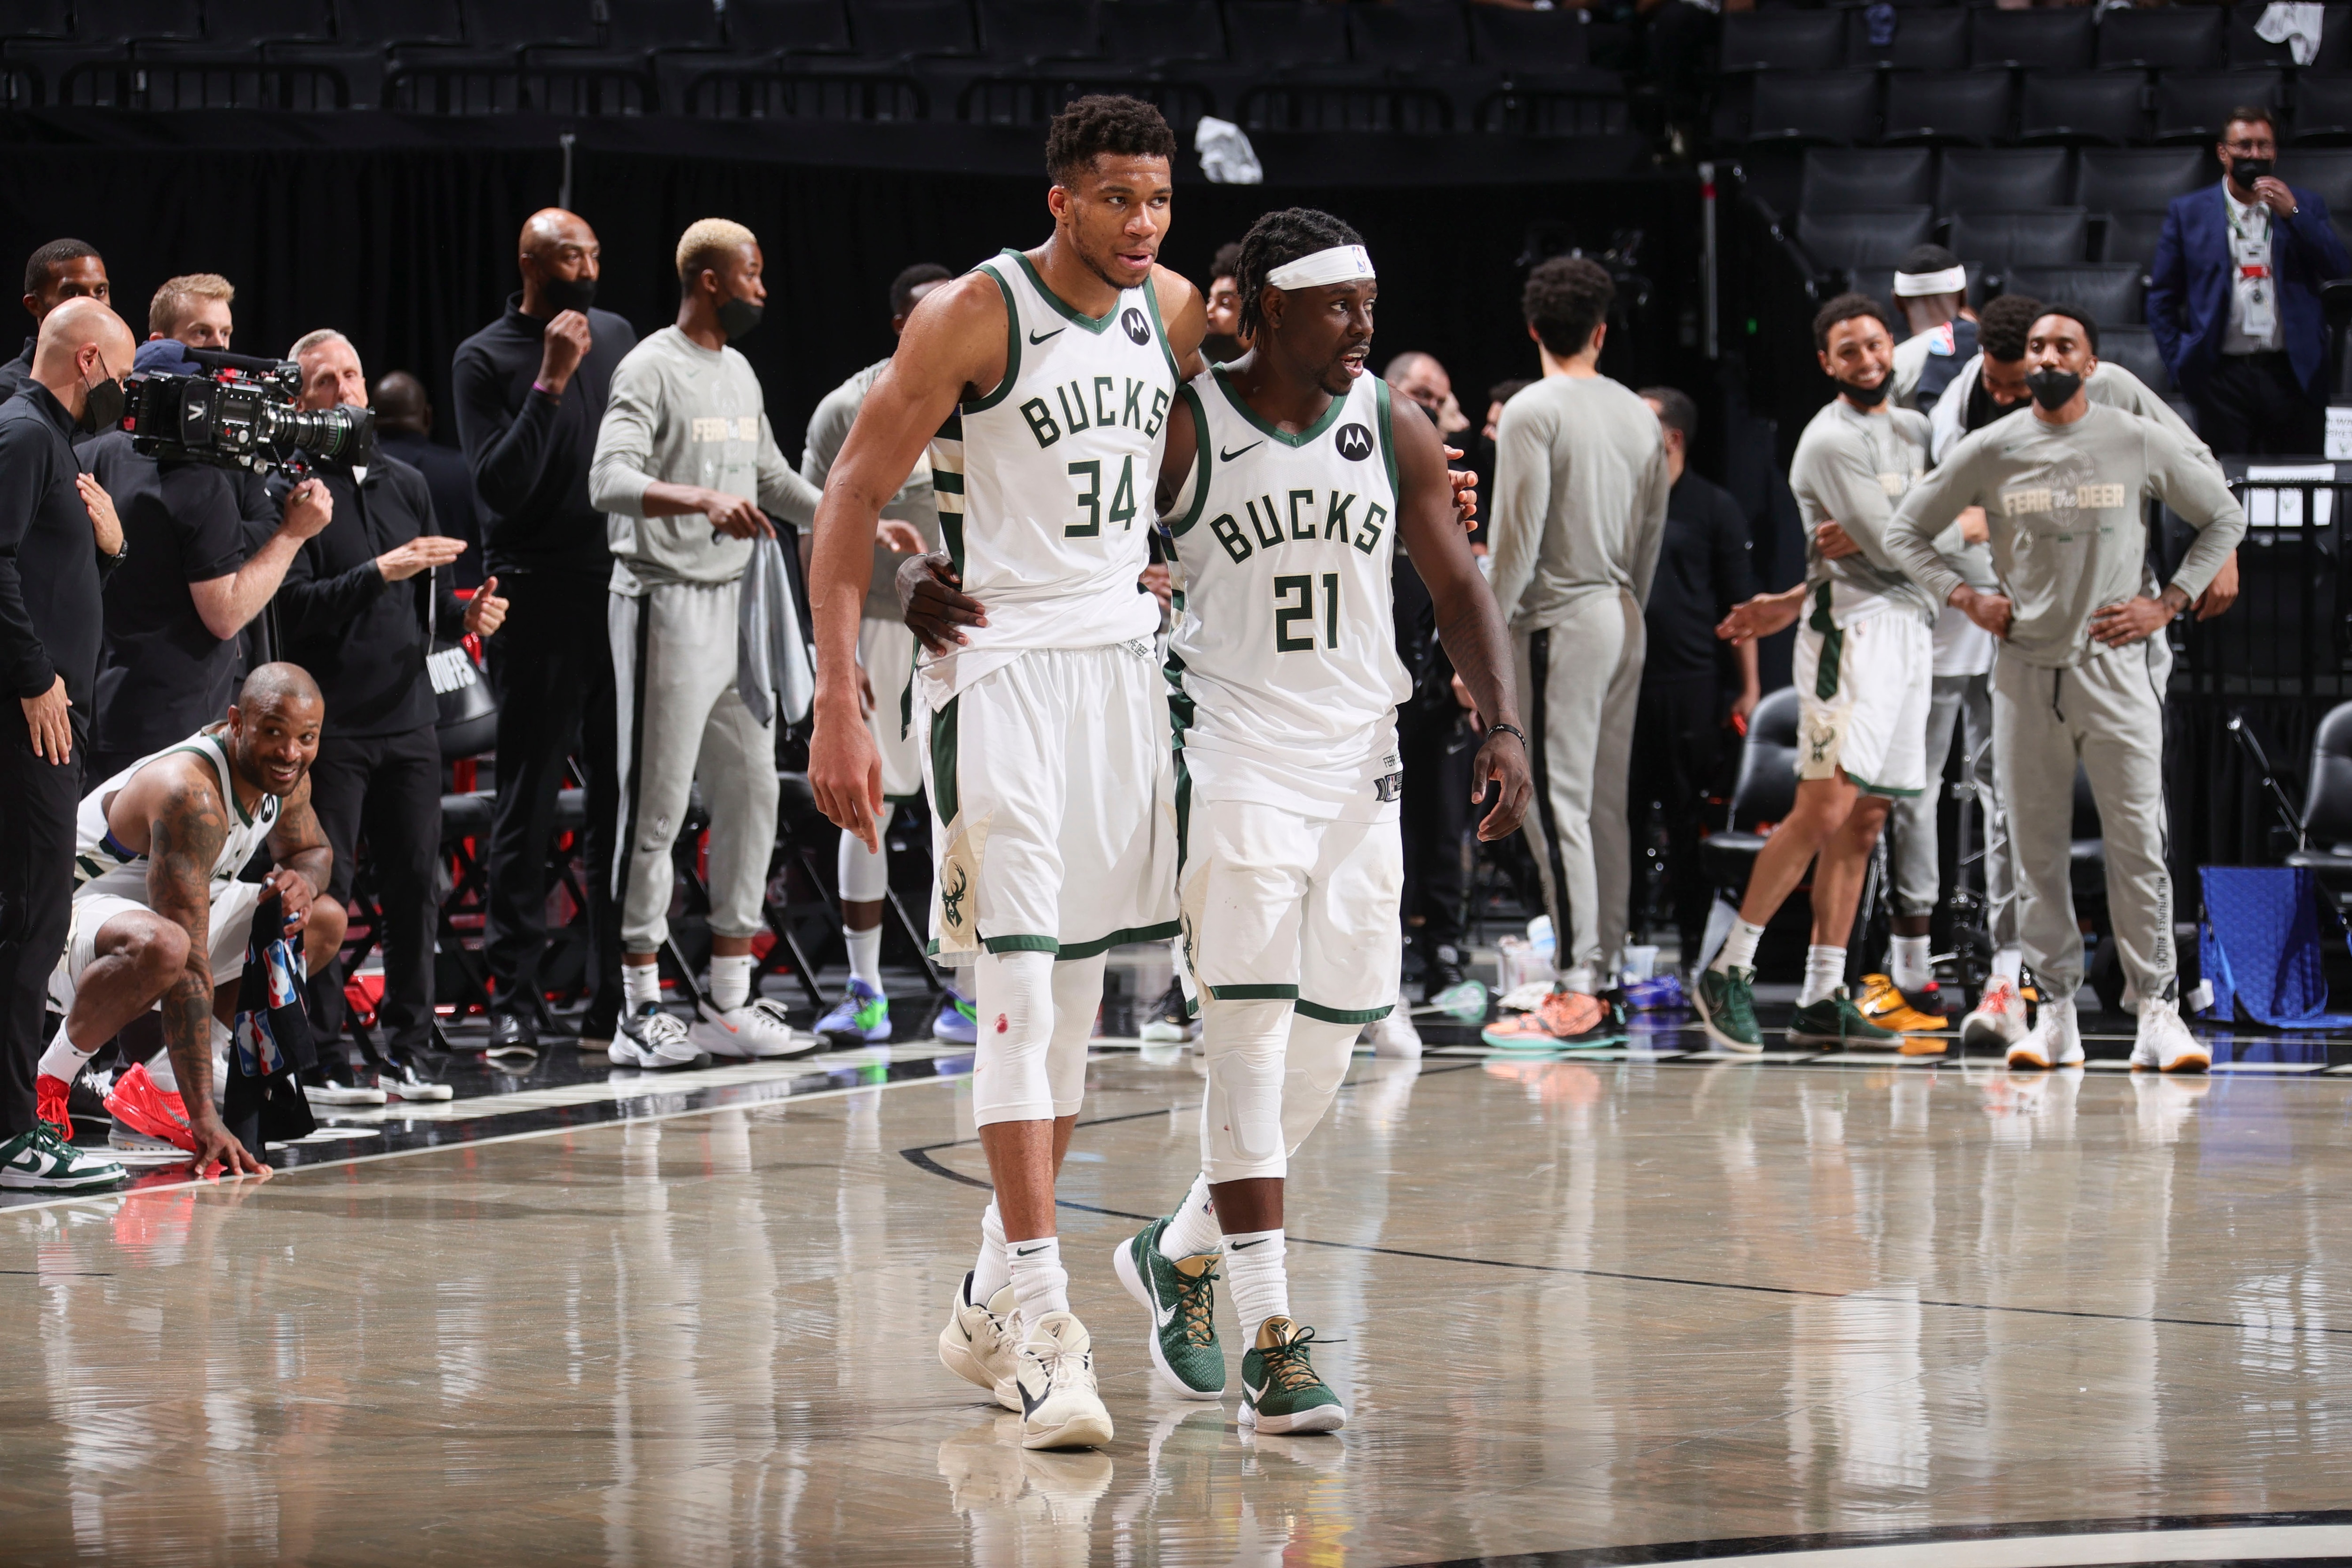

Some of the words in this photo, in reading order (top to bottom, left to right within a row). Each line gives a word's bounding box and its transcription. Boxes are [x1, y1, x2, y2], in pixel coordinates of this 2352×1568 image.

[1018, 375, 1170, 451] BUCKS
[1062, 454, 1137, 541] 34
[1209, 488, 1388, 566] BUCKS
[2002, 487, 2052, 517] FEAR
[2077, 483, 2125, 509] DEER
[1273, 571, 1341, 655] 21
[2157, 937, 2168, 970] BUCKS
